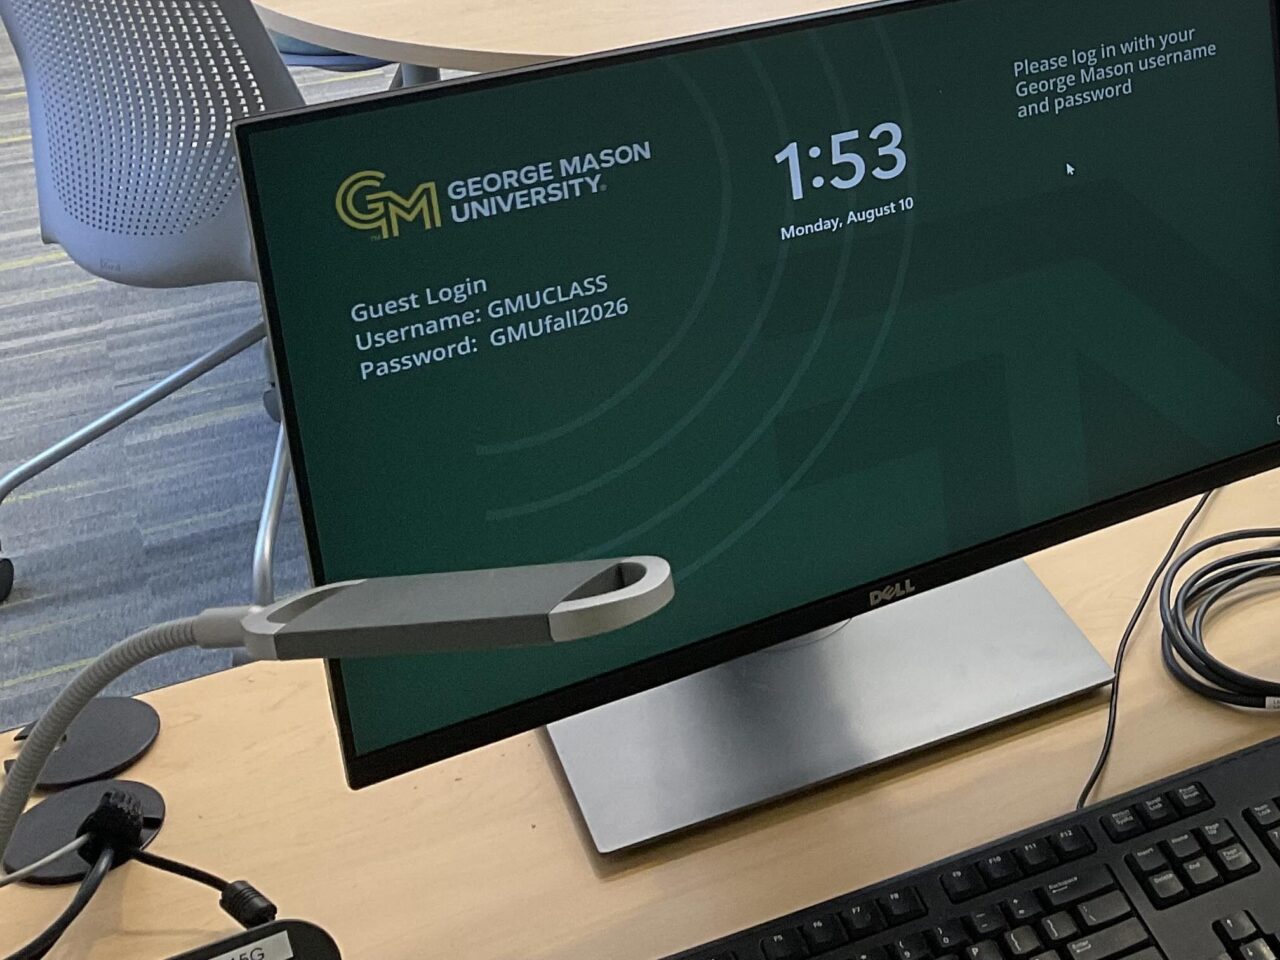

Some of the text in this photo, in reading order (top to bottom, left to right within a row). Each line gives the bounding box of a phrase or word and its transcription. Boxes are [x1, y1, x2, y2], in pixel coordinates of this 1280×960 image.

[1014, 27, 1196, 77] Please log in with your
[1015, 43, 1217, 97] George Mason username
[1017, 78, 1133, 118] and password
[447, 141, 651, 200] GEORGE MASON
[774, 122, 908, 201] 1:53
[451, 174, 603, 223] UNIVERSITY
[780, 196, 914, 241] Monday, August 10
[350, 277, 487, 322] Guest Login
[355, 275, 609, 351] Username: GMUCLASS
[360, 297, 629, 380] Password: GMUfall2026
[869, 579, 916, 607] DELL
